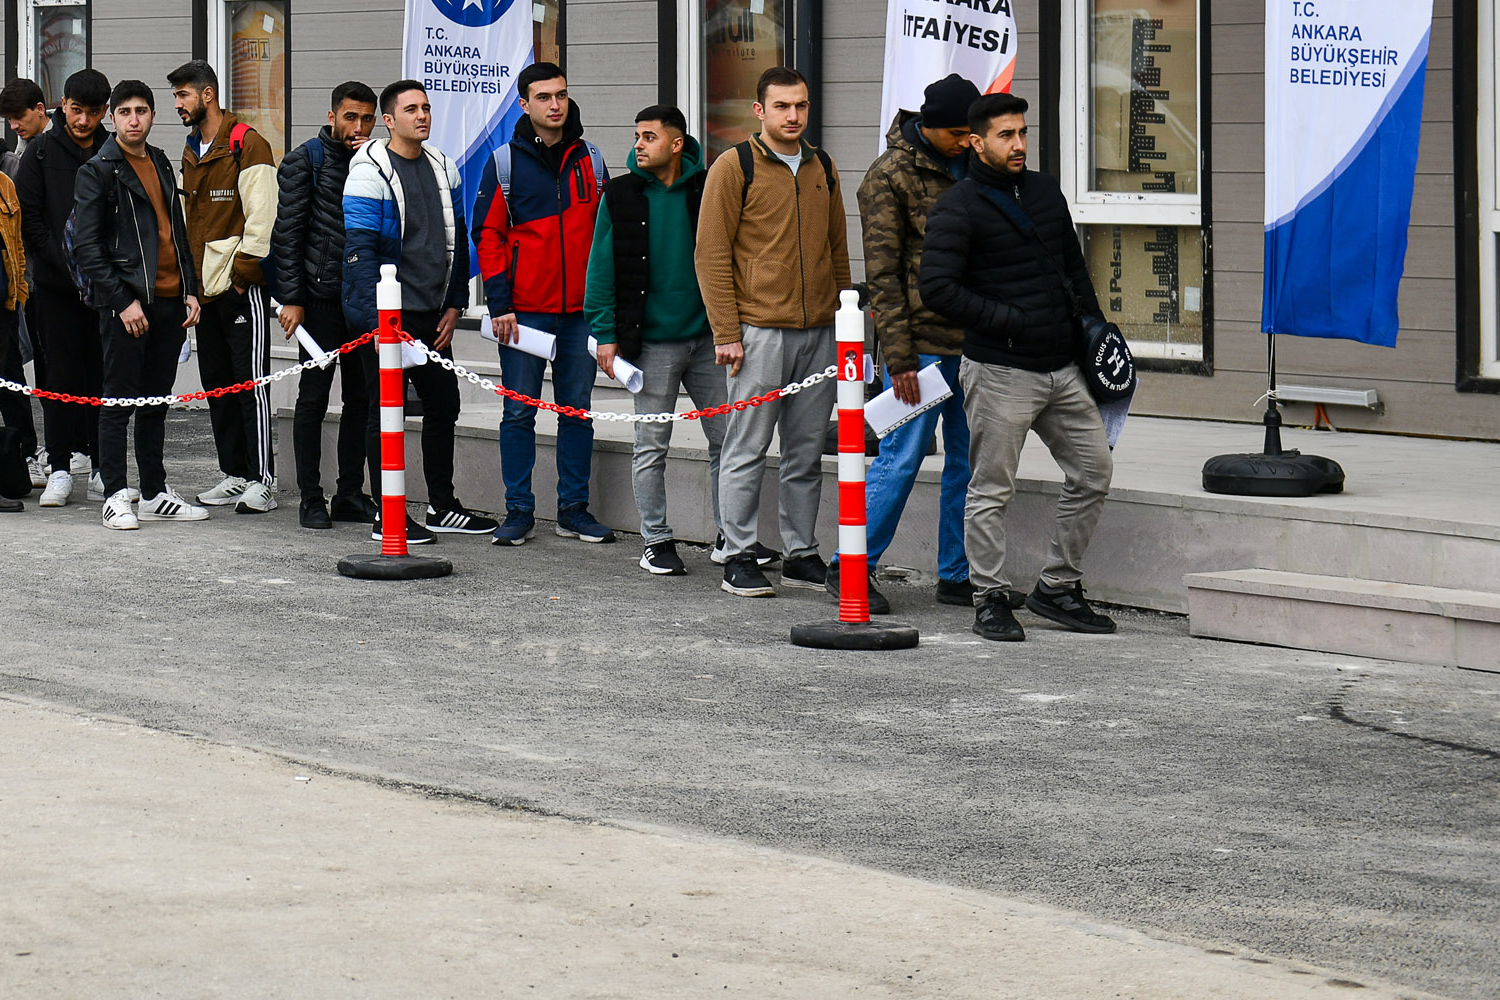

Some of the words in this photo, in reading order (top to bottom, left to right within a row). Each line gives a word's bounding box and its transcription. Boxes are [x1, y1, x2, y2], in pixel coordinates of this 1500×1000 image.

[1293, 1, 1320, 18] T.C.
[425, 27, 449, 41] T.C.
[903, 9, 1009, 55] İTFAİYESİ
[1291, 24, 1363, 42] ANKARA
[424, 44, 482, 60] ANKARA
[1291, 43, 1399, 68] BÜYÜKŞEHİR
[424, 59, 511, 80] BÜYÜKŞEHİR
[1290, 67, 1387, 88] BELEDİYESİ
[424, 78, 502, 95] BELEDİYESİ
